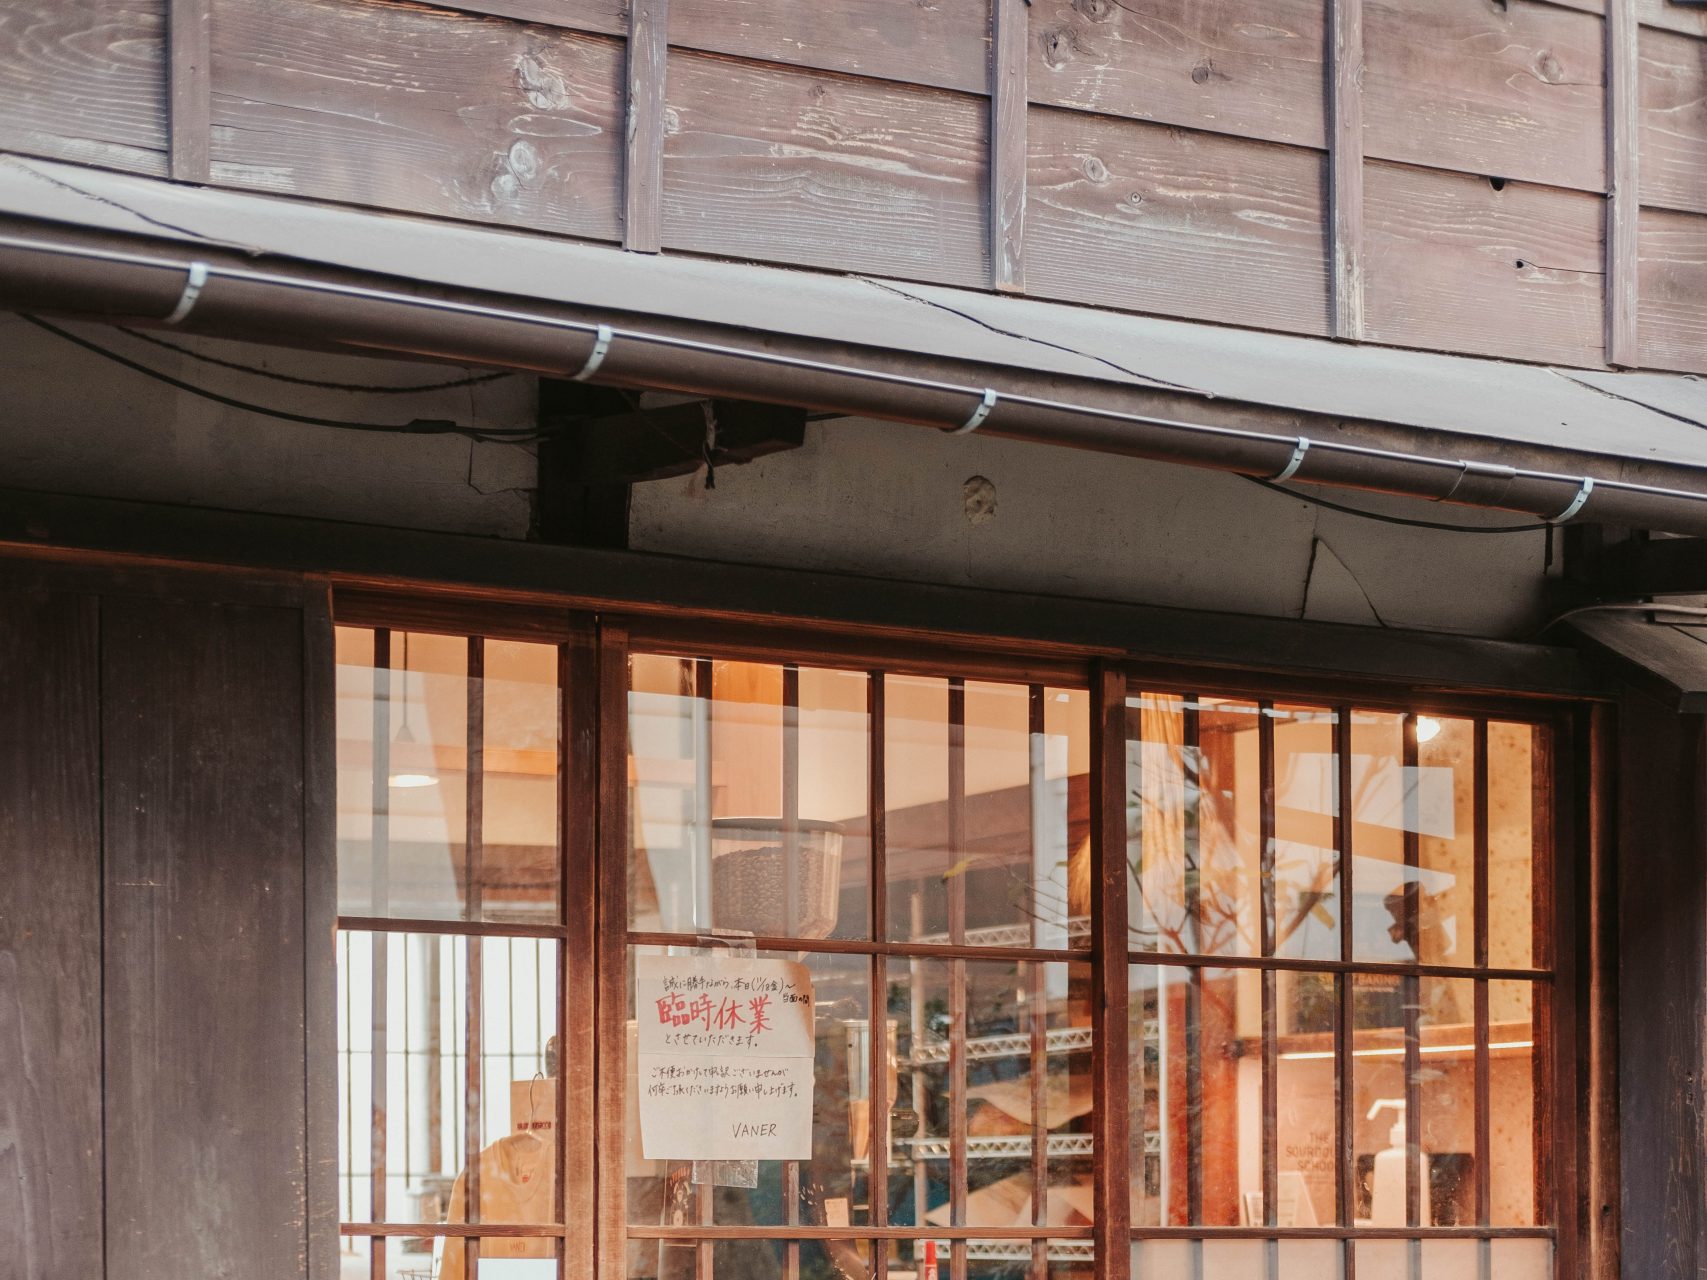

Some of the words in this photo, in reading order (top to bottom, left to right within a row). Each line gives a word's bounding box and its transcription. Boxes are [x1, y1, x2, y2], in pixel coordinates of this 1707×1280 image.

[656, 991, 773, 1034] 臨時休業
[732, 1122, 777, 1138] VANER
